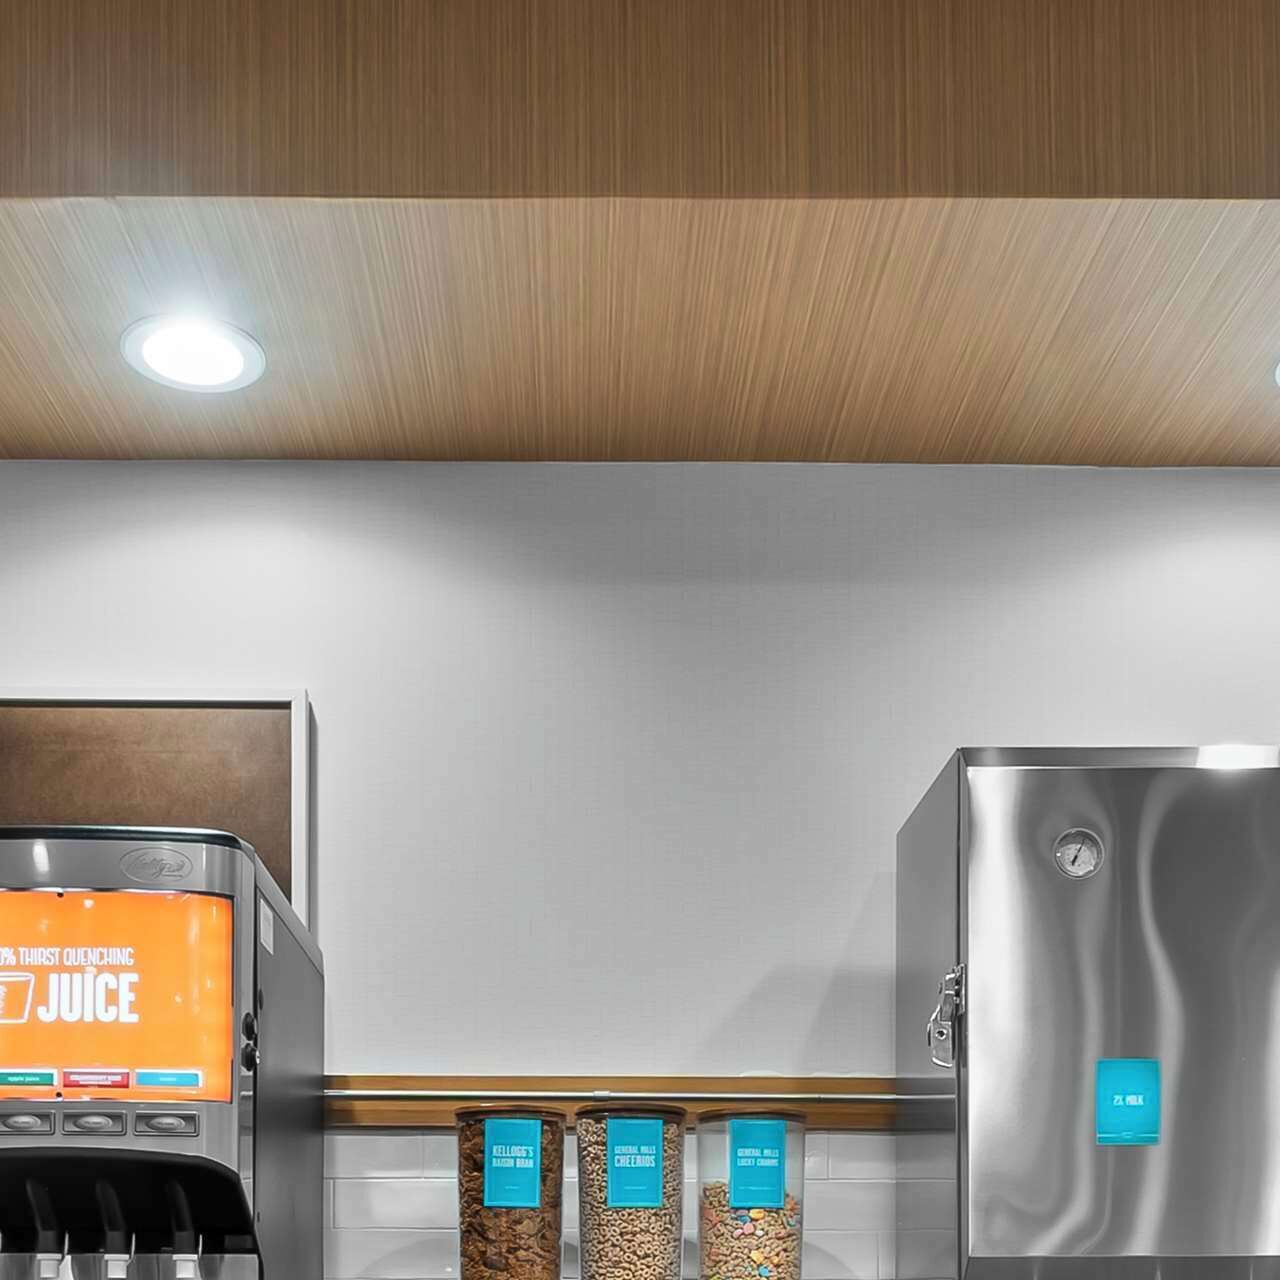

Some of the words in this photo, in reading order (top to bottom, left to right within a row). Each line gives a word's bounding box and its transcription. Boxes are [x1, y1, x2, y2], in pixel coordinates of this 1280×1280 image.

[18, 946, 62, 967] THIRST
[63, 946, 135, 967] QUENCHING
[36, 971, 140, 1024] JUICE
[492, 1144, 535, 1158] KELLOGG'S
[614, 1154, 656, 1168] CHEERIOS
